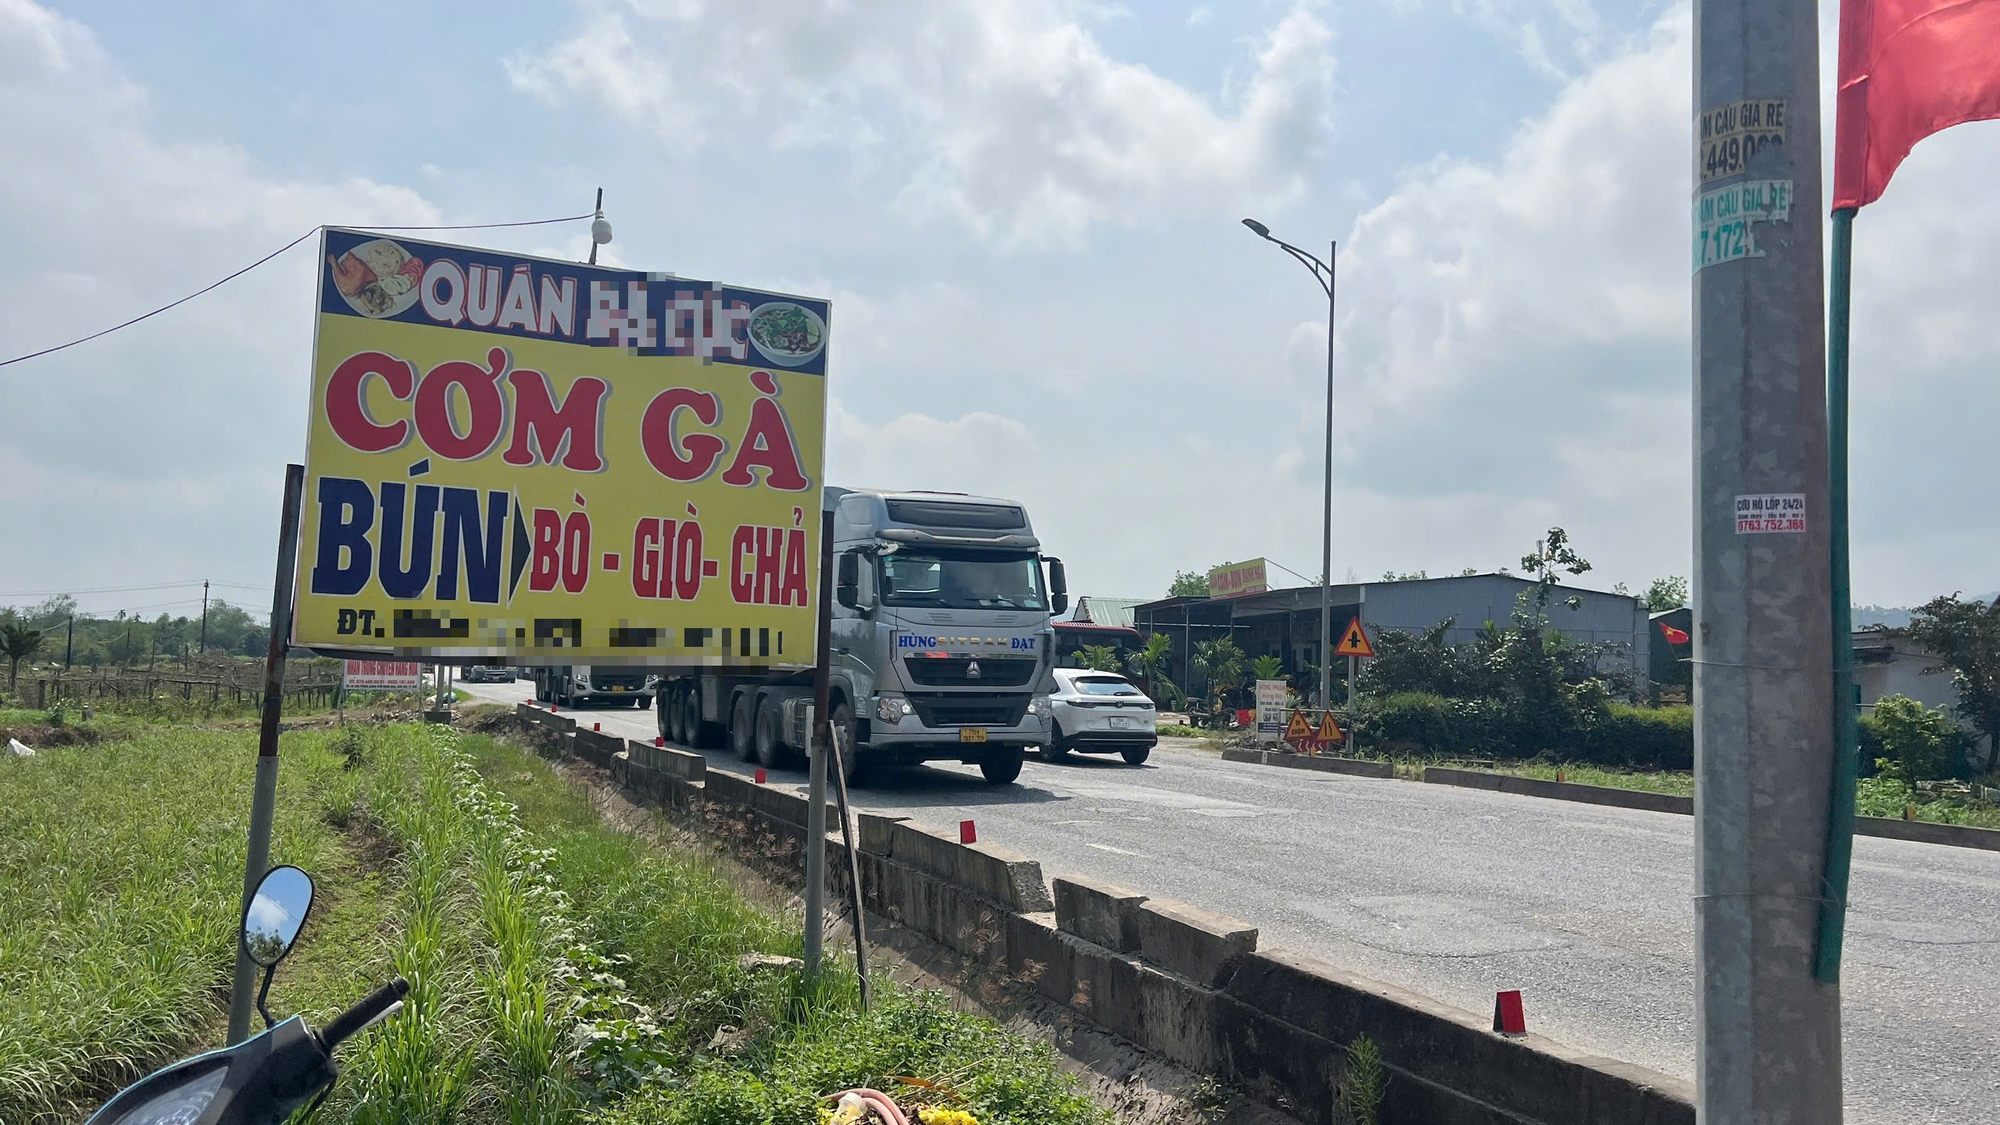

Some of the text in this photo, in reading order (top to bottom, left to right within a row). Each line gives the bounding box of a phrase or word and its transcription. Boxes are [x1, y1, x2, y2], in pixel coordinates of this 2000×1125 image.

[419, 258, 578, 338] QUÁN
[325, 346, 810, 492] CƠM GÀ
[312, 457, 509, 604] BÚN
[529, 492, 592, 595] BÒ
[632, 500, 702, 601] GIÒ
[730, 506, 810, 608] CHẢ
[898, 632, 937, 648] HÙNG
[1011, 637, 1036, 652] ĐẠT
